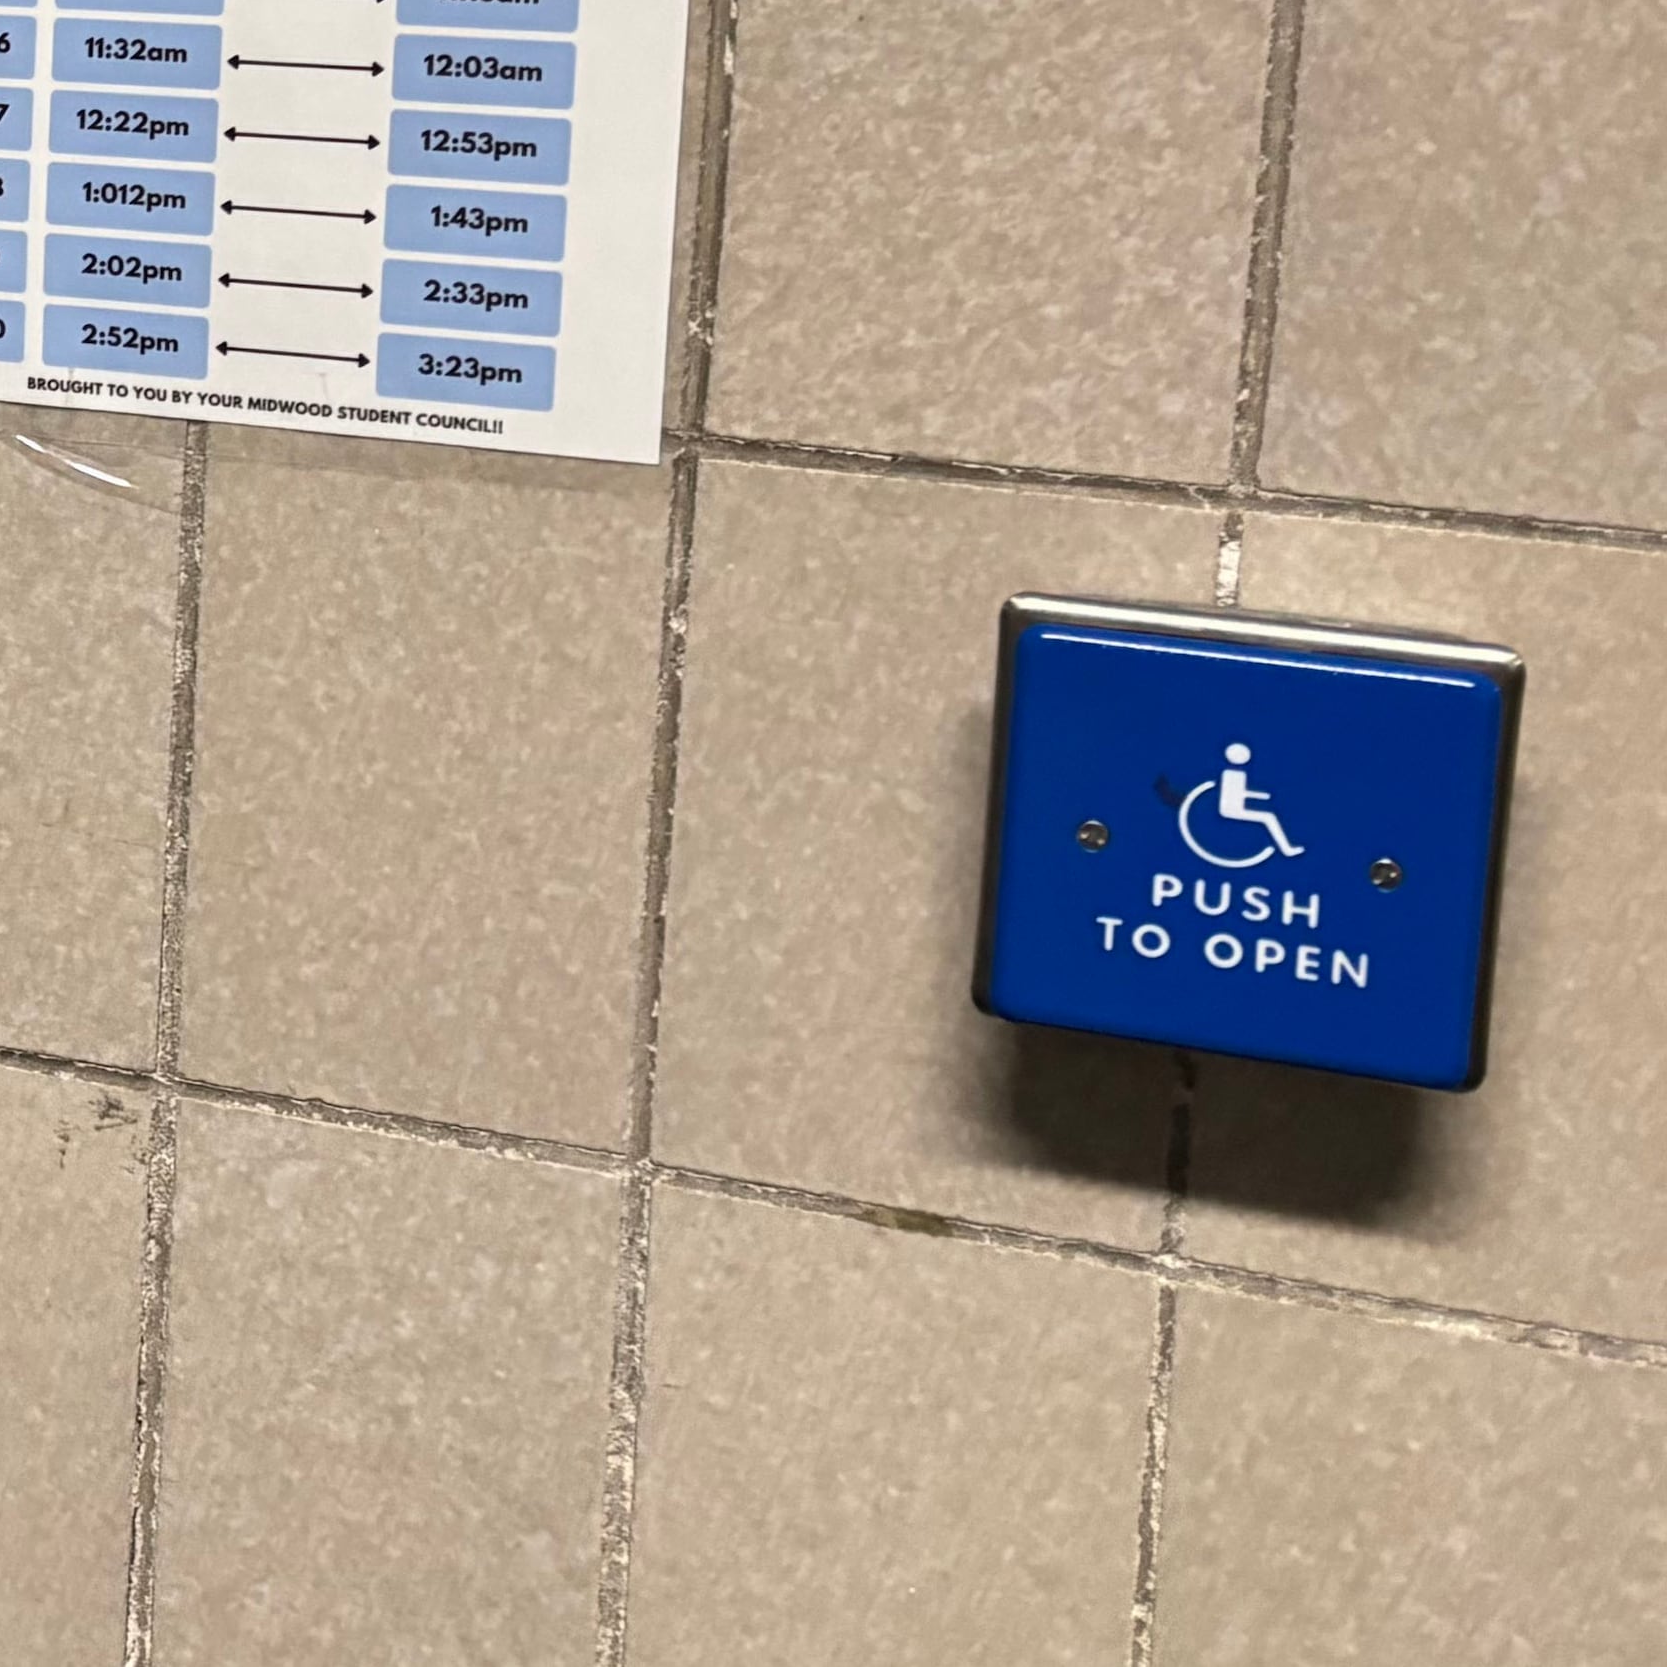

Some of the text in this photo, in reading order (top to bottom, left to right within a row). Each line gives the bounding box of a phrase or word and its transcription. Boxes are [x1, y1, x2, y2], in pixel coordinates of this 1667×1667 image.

[84, 36, 188, 63] 11:32am
[423, 53, 543, 82] 12:03am
[76, 108, 189, 141] 12:22pm
[420, 129, 537, 162] 12:53pm
[82, 181, 186, 213] 1:012pm
[430, 205, 528, 237] 1:43pm
[81, 252, 182, 285] 2:02pm
[423, 279, 529, 313] 2:33pm
[81, 323, 179, 356] 2:52pm
[417, 353, 522, 386] 3:23pm
[27, 376, 503, 434] BROUGHT TO YOU BY YOUR MIDWOOD STUDENT COUNCIL!!
[1151, 874, 1320, 930] PUSH
[1096, 916, 1368, 988] TO OPEN
